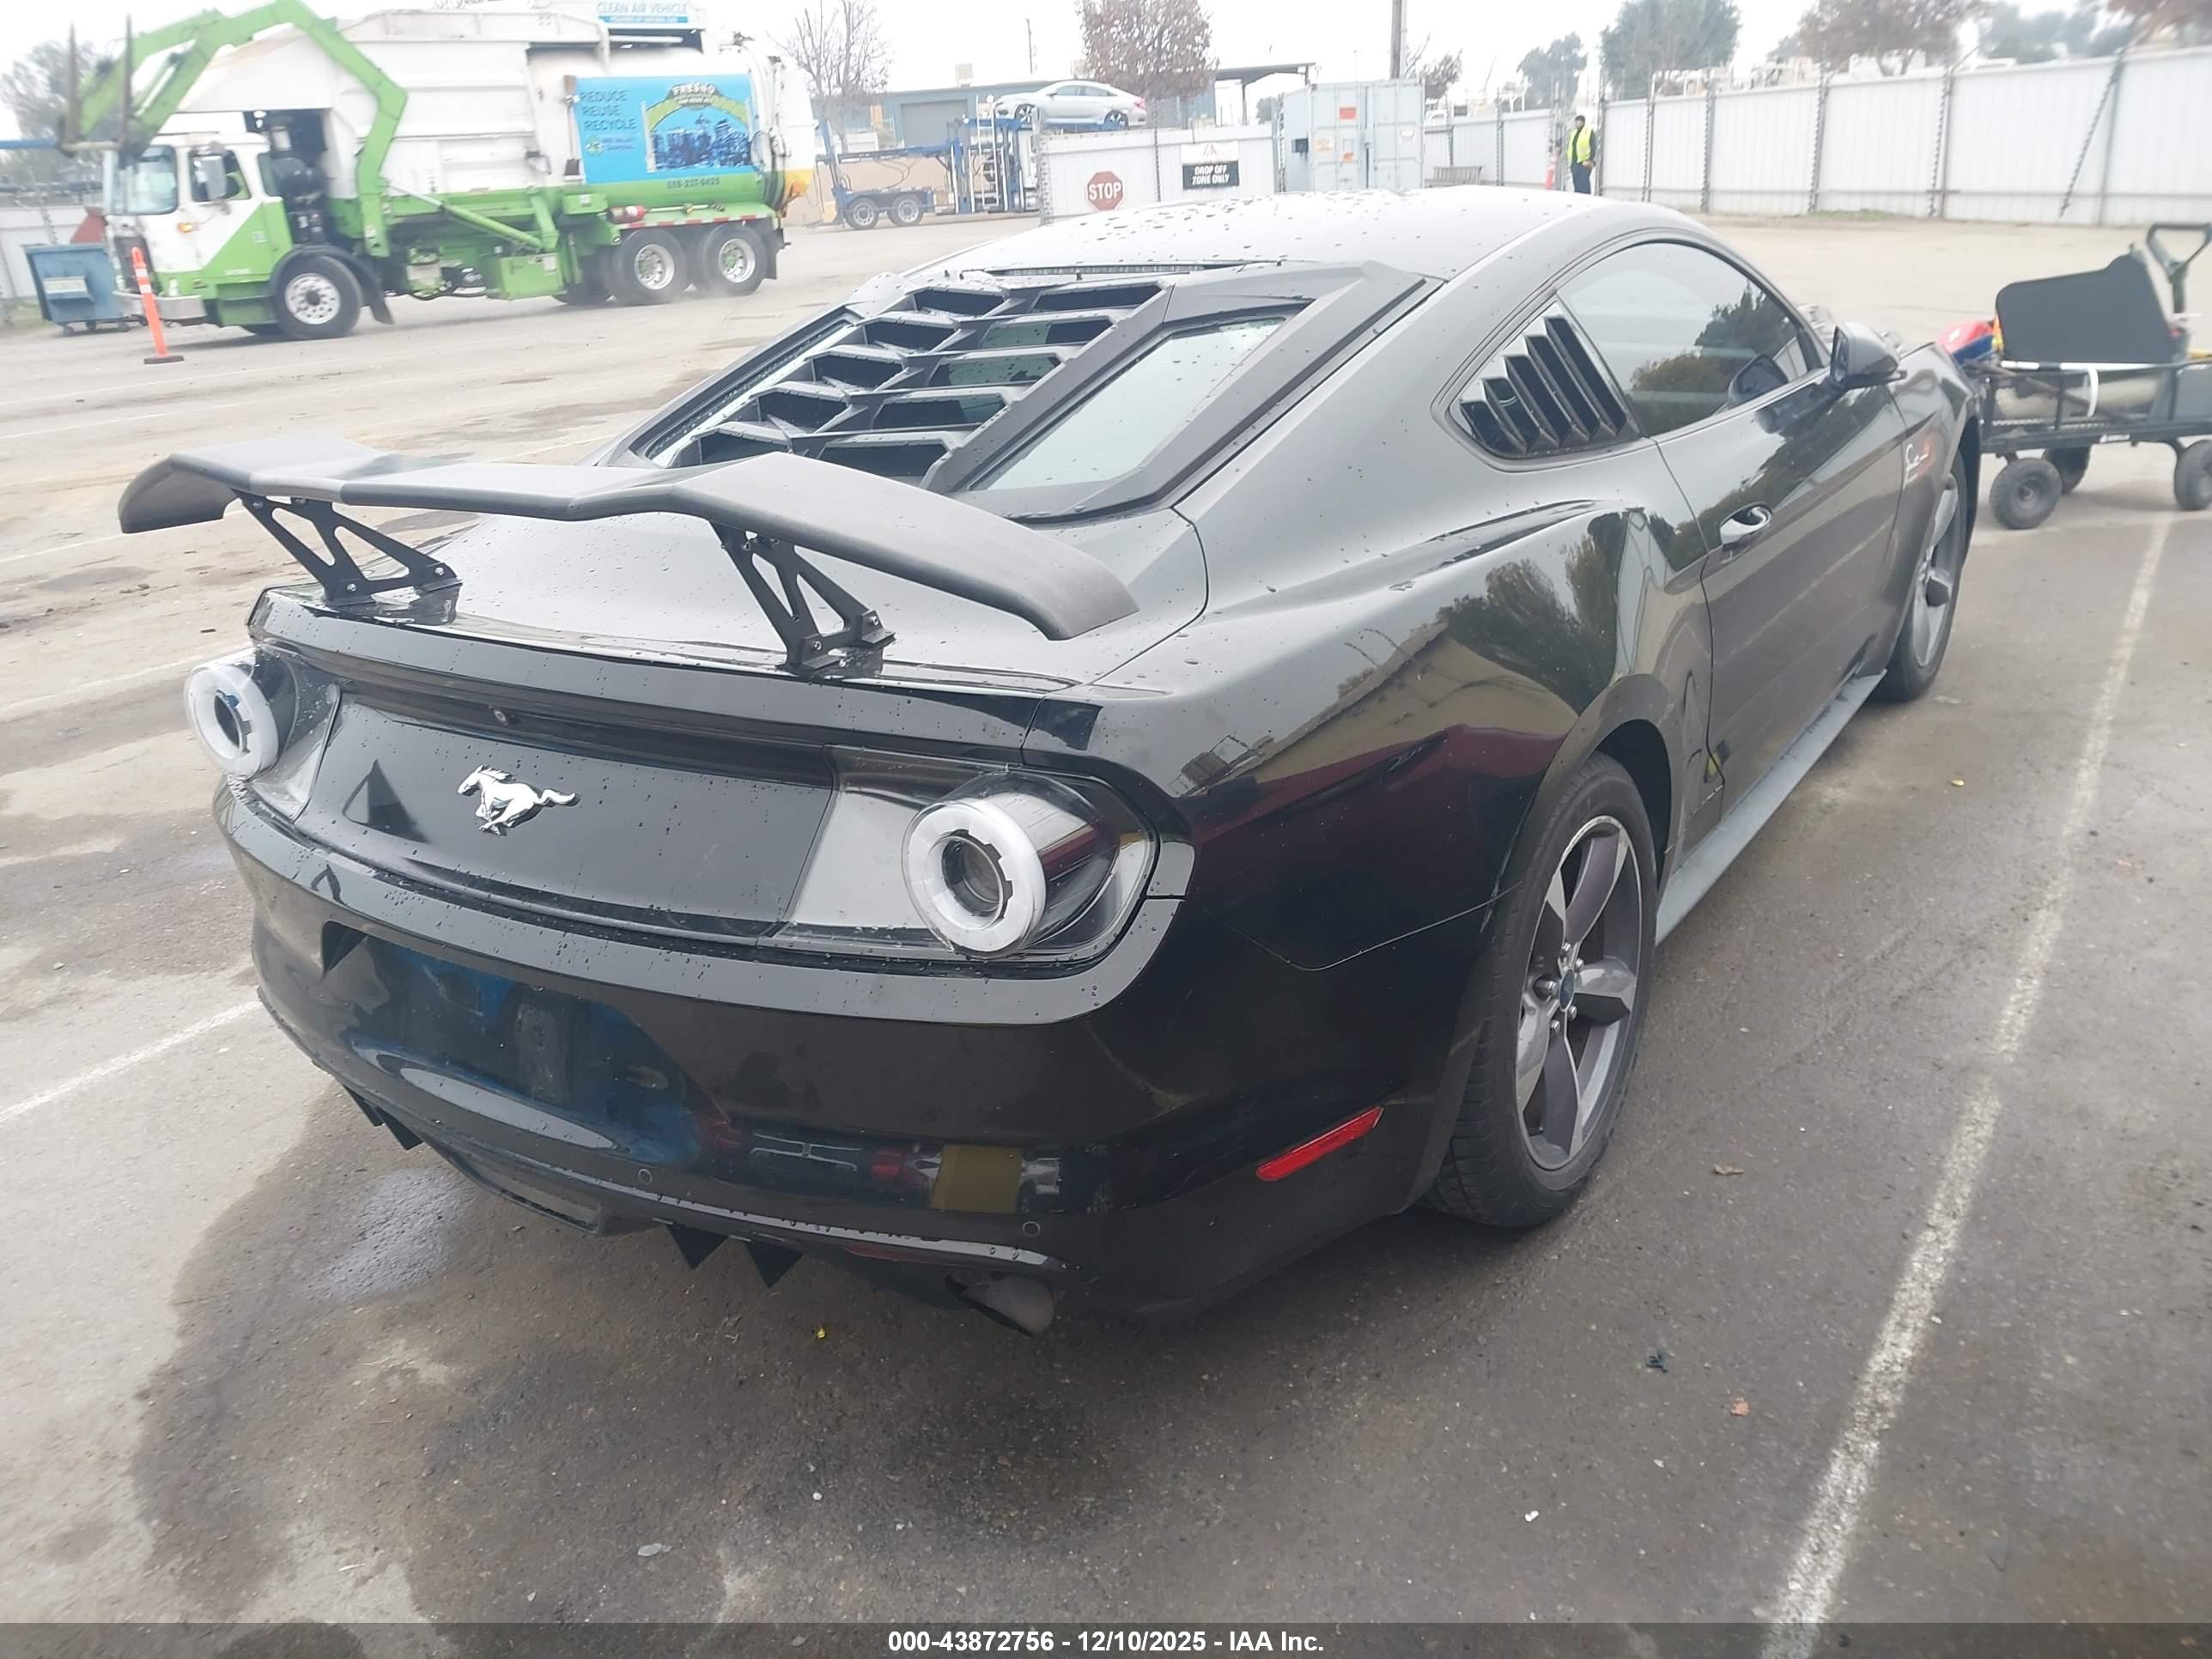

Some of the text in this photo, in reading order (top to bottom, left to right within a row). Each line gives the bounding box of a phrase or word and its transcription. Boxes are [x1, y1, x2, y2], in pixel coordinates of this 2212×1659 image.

[597, 2, 688, 15] CLEAN AIR VEHICLE
[580, 90, 627, 102] REDUCE
[582, 105, 620, 117] REUSE
[584, 118, 637, 131] RECYCLE
[1194, 164, 1228, 175] DROP OFF
[1192, 173, 1231, 185] ZONE ONLY
[1088, 181, 1122, 201] STOP
